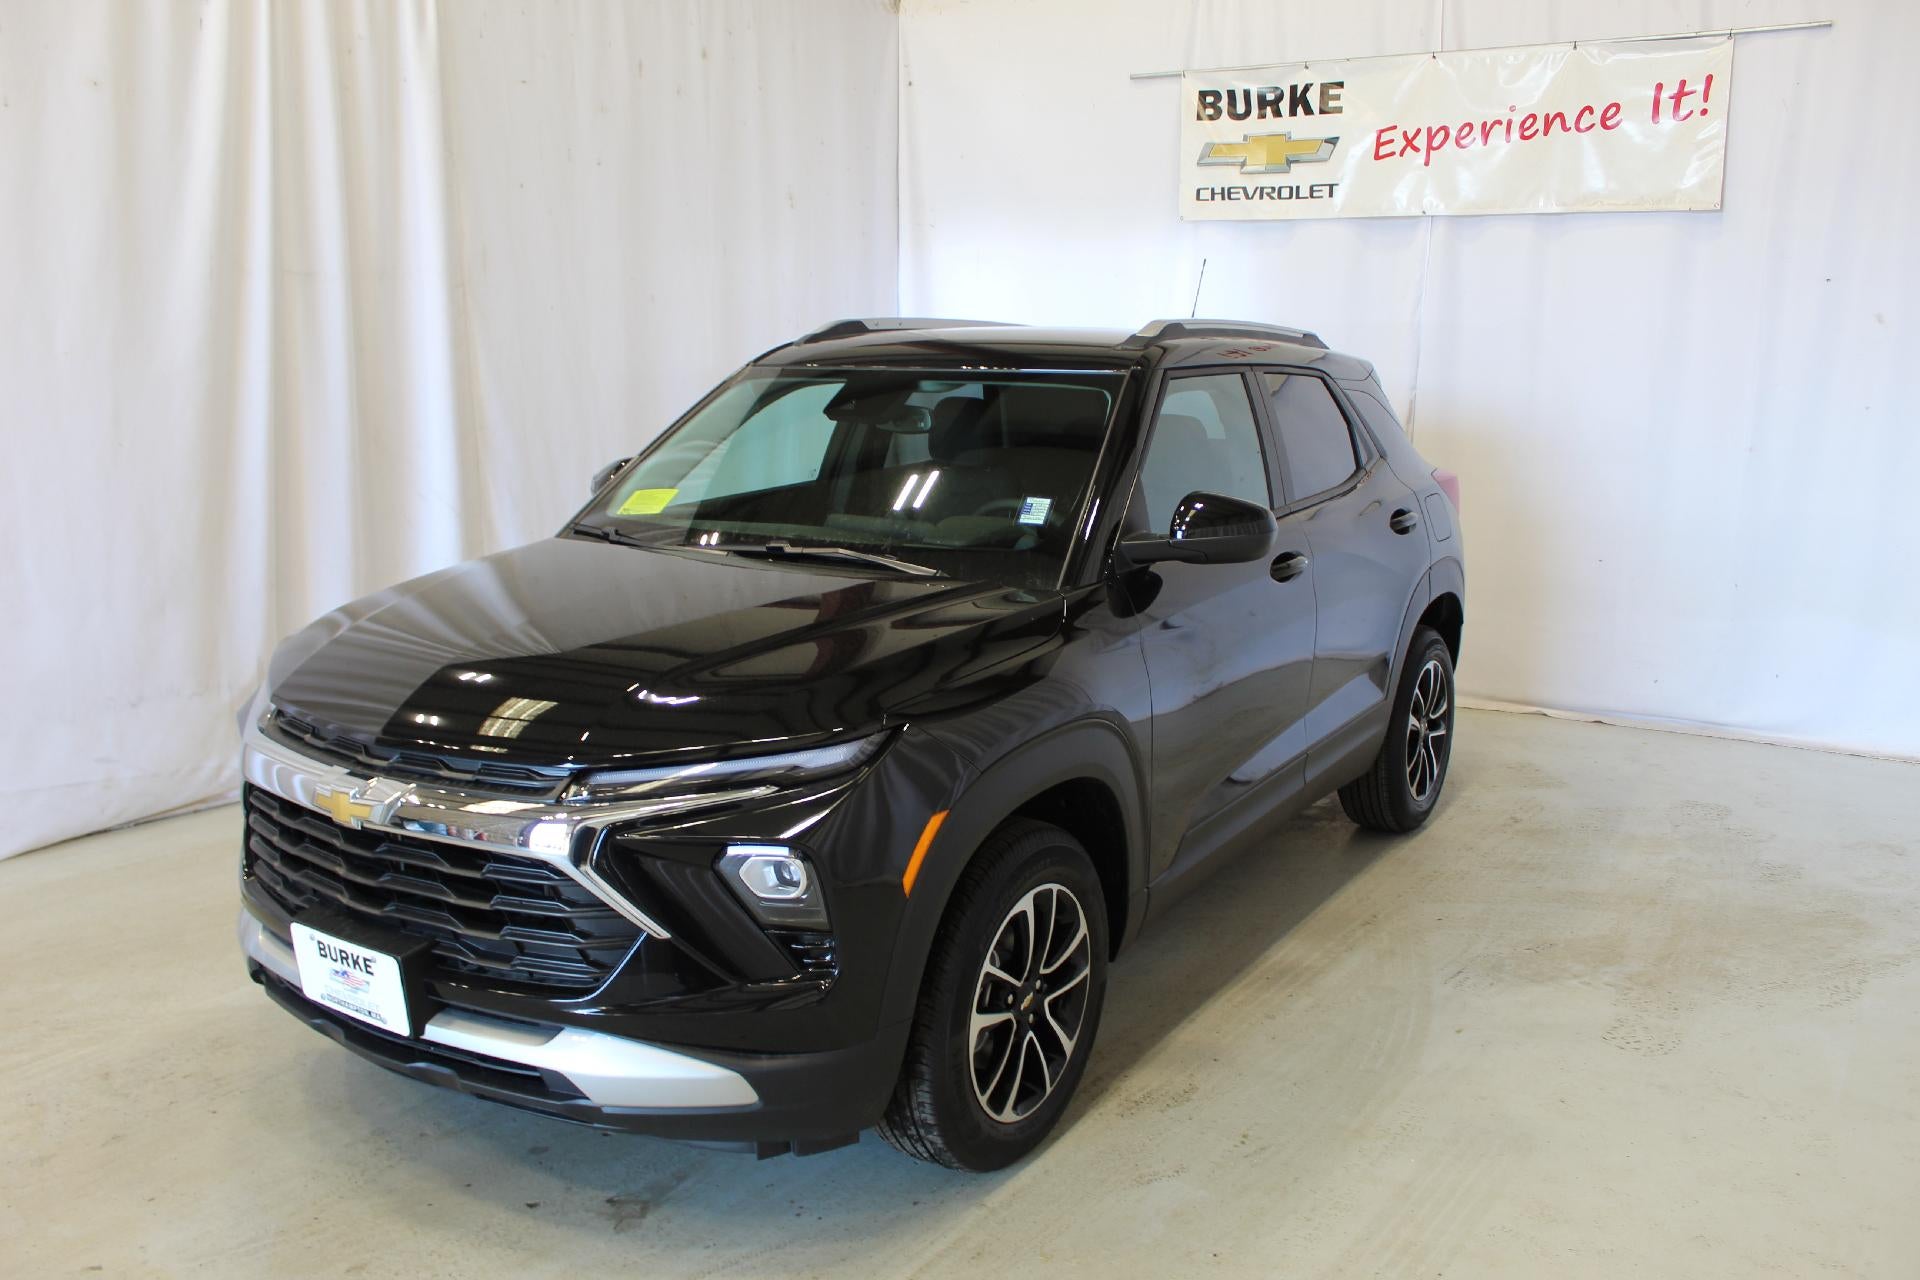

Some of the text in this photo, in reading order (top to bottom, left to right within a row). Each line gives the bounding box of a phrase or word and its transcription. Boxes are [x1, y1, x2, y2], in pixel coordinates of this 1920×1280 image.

[1196, 80, 1344, 121] BURKE
[1373, 73, 1714, 167] Experience It!
[1195, 183, 1340, 202] CHEVROLET
[316, 939, 375, 977] BURKE
